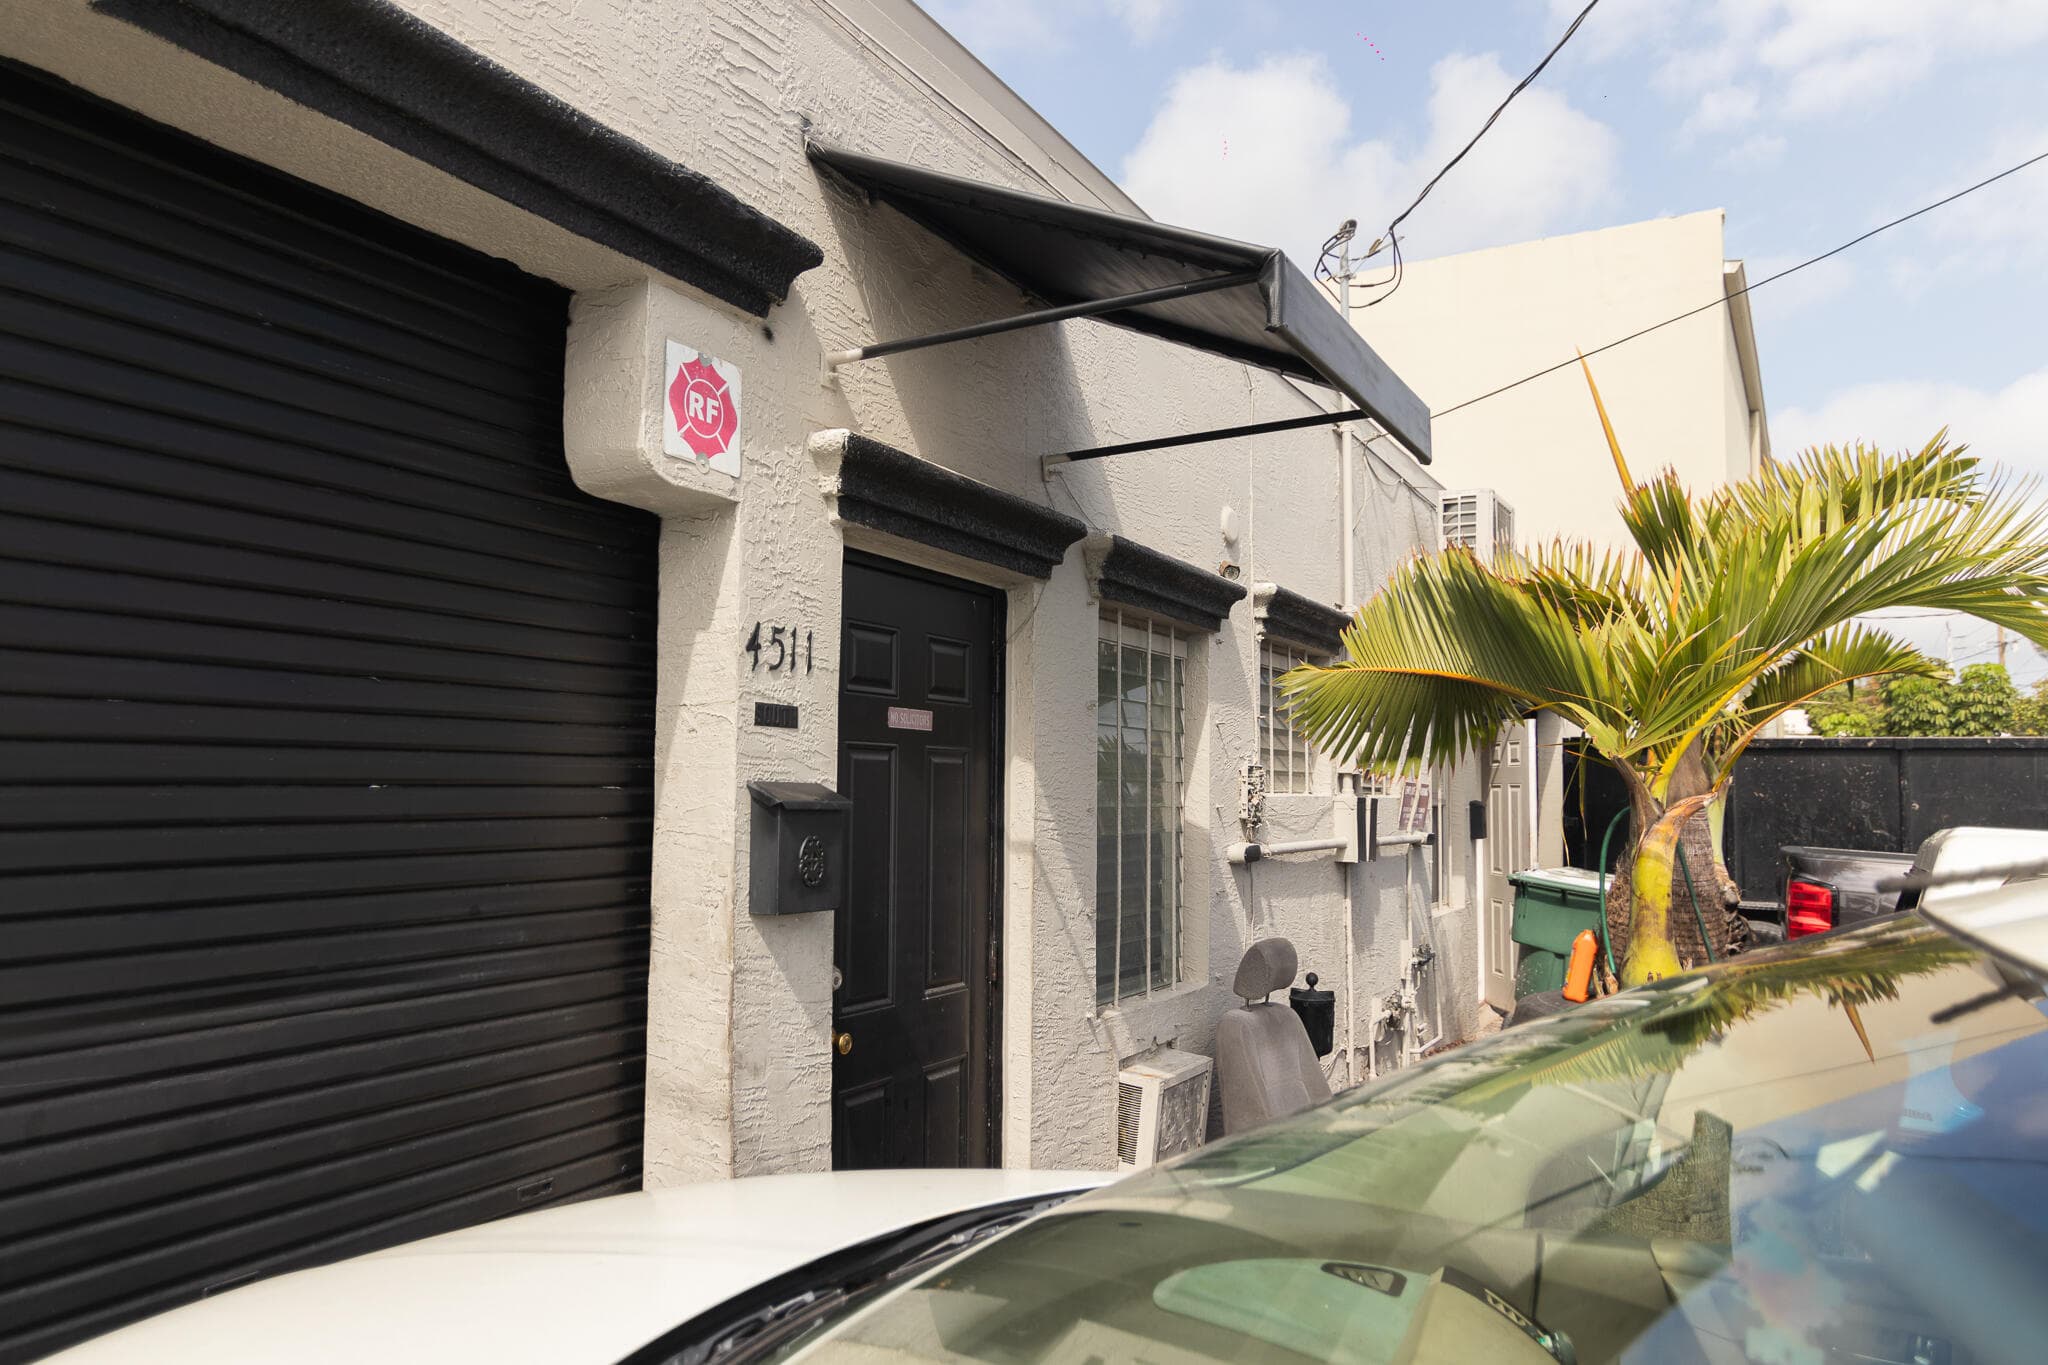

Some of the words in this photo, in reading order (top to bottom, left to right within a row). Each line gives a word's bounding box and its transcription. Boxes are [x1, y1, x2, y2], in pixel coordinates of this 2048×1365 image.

[689, 390, 719, 424] RF
[745, 621, 813, 675] 4511
[890, 711, 899, 725] NO
